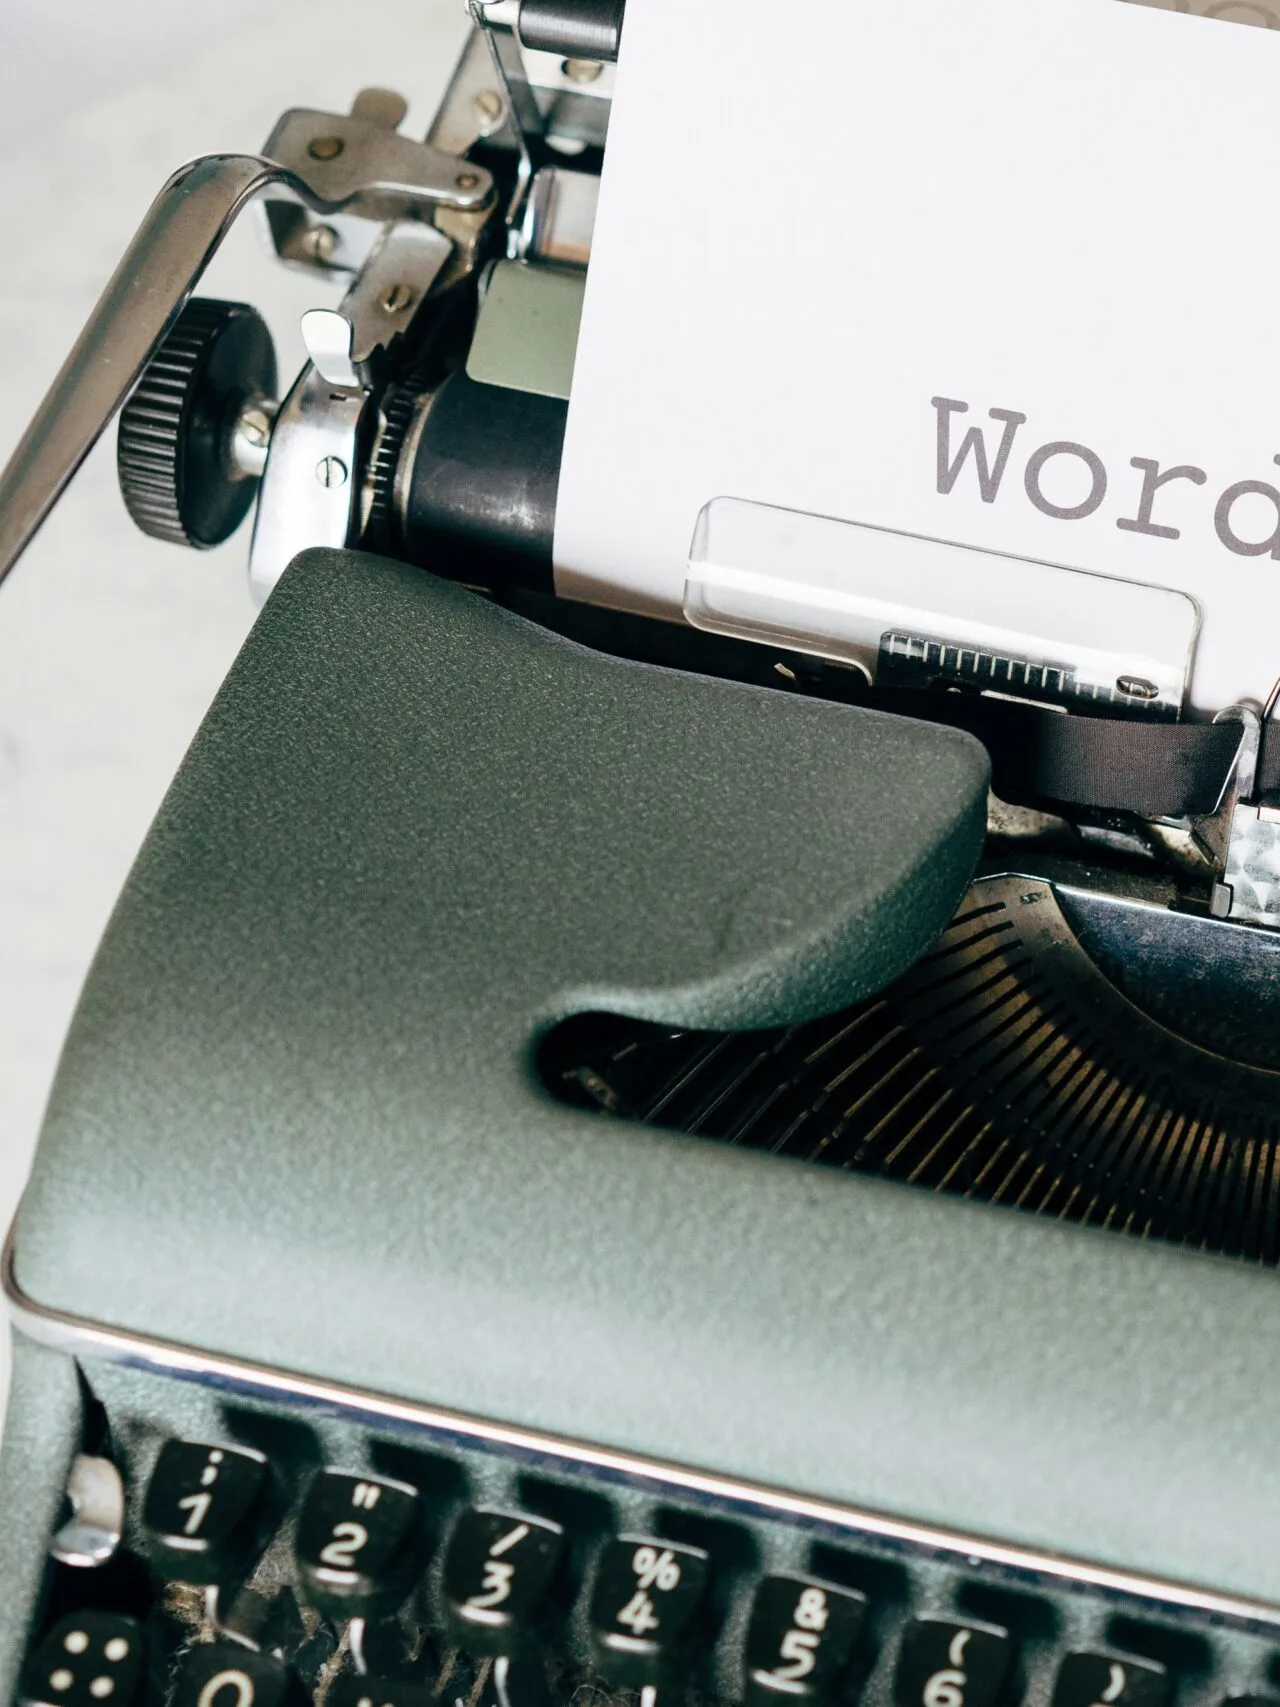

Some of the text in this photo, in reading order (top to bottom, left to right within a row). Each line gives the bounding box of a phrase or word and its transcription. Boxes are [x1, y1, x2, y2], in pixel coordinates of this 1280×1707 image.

[178, 1492, 212, 1535] 1
[320, 1521, 368, 1567] 2
[465, 1560, 515, 1608] 3
[632, 1546, 680, 1591] %
[616, 1589, 660, 1635] 4
[772, 1629, 821, 1680] 5
[923, 1668, 967, 1707] 6
